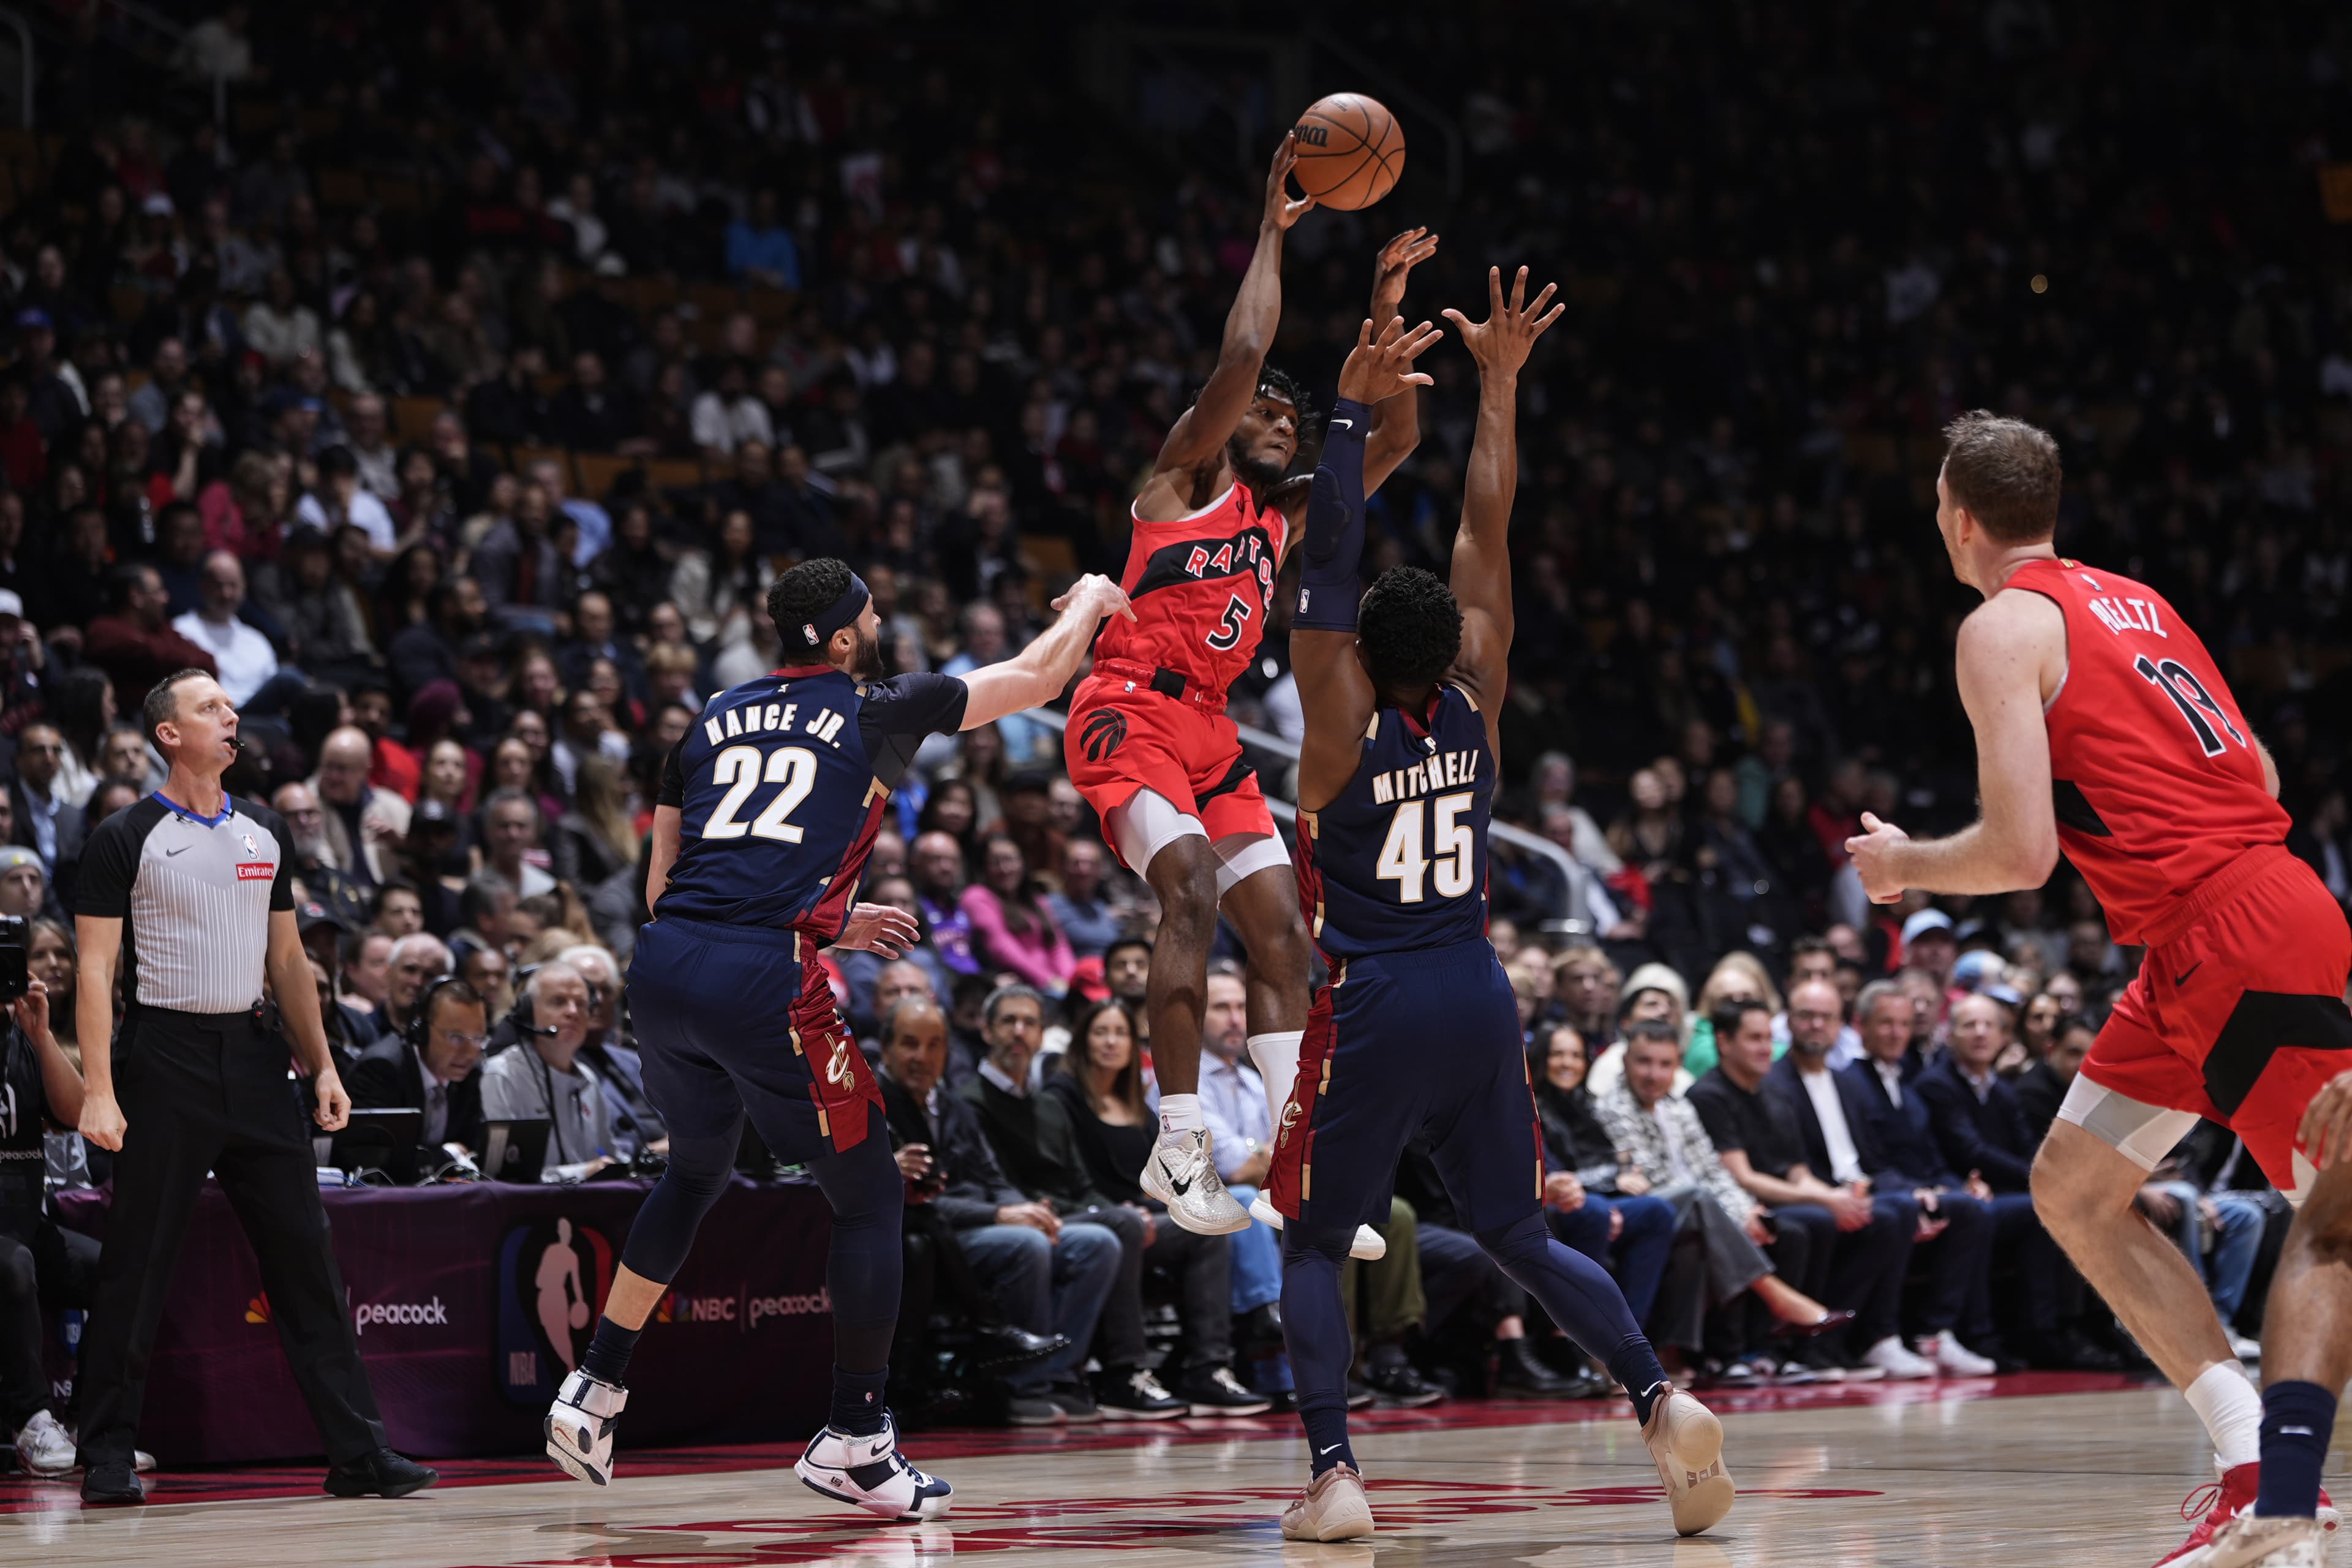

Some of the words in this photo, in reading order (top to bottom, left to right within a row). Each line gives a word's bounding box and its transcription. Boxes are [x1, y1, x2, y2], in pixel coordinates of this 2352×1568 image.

[1185, 535, 1274, 612] RATOR
[1205, 593, 1252, 650] 5
[704, 704, 798, 746] NANCE
[805, 707, 845, 749] JR.
[2133, 653, 2247, 758] 19
[702, 745, 818, 844] 22
[1373, 749, 1479, 805] MITCHELL
[238, 865, 273, 877] Emirates
[1376, 791, 1474, 903] 45
[356, 1295, 448, 1336] peacock
[692, 1296, 736, 1322] NBC
[509, 1352, 537, 1385] NBA
